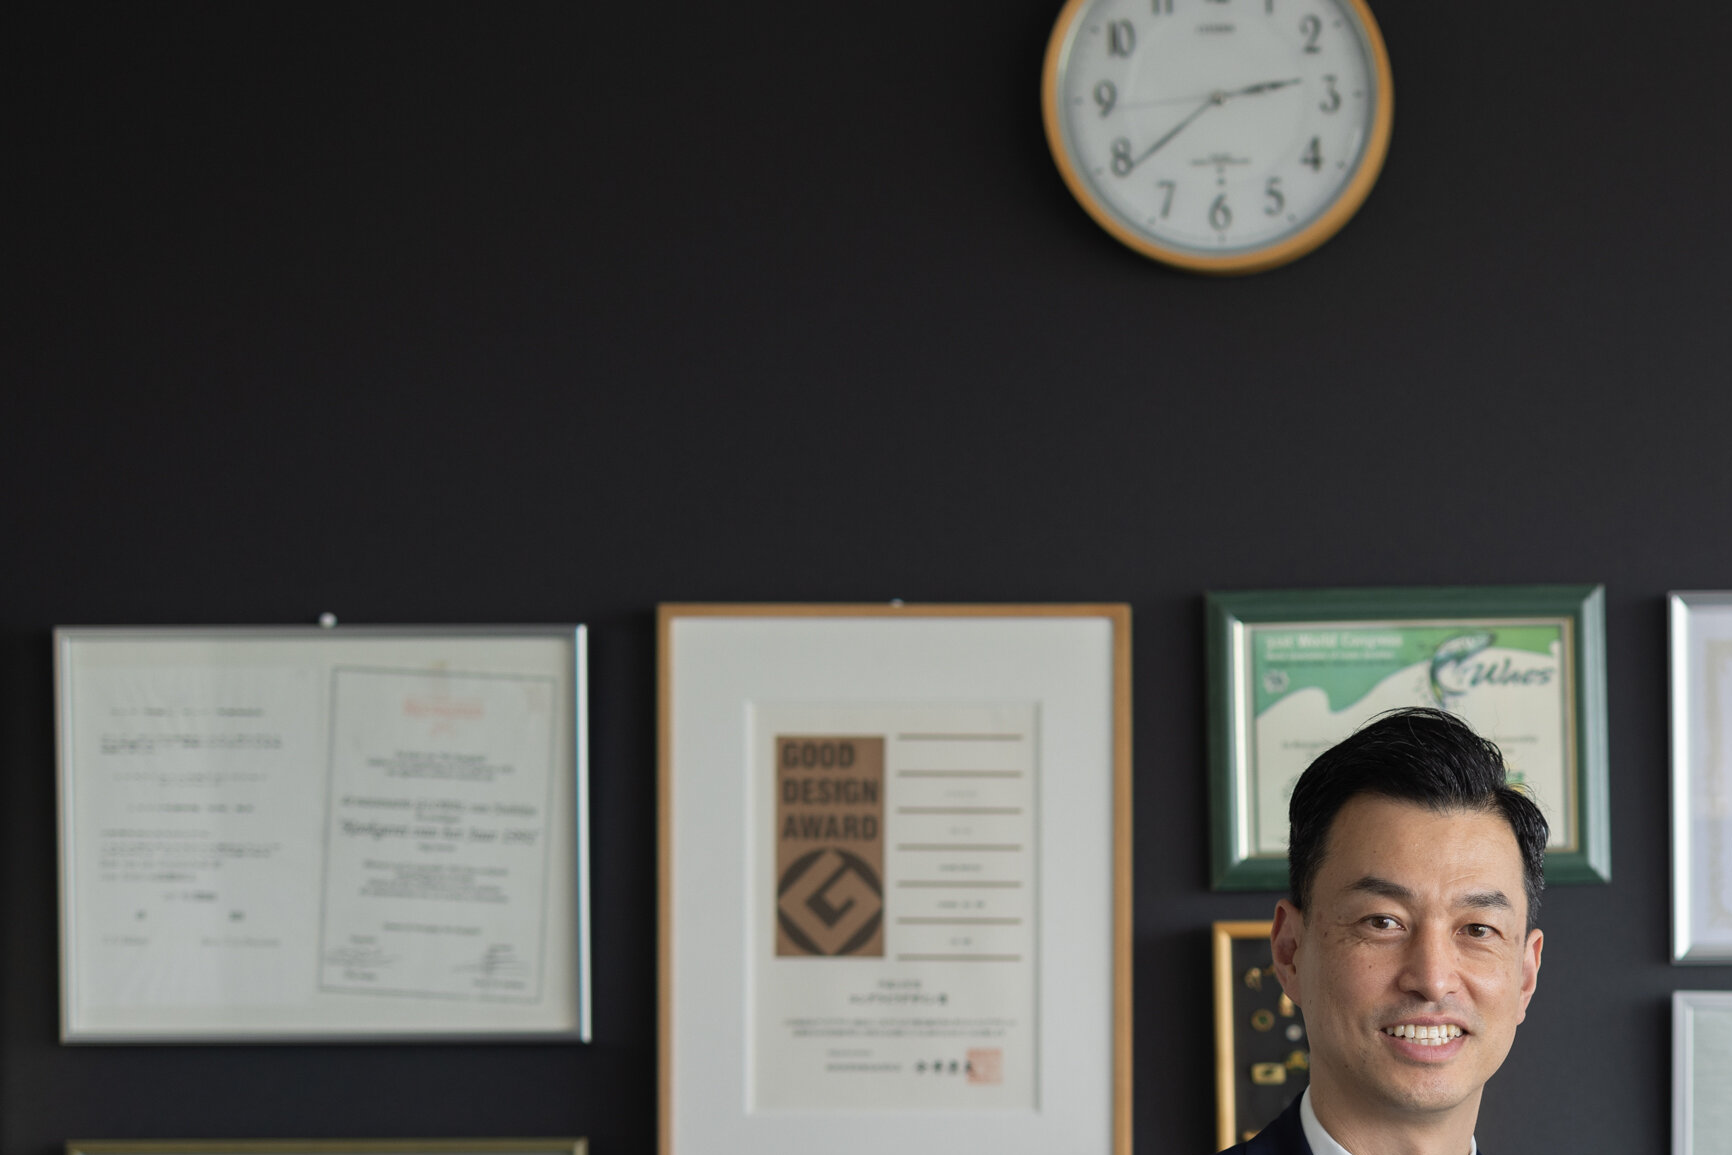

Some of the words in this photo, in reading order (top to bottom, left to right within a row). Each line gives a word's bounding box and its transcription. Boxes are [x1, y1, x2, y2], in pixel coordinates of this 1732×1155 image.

[1107, 19, 1136, 58] 10
[1300, 14, 1322, 53] 2
[1093, 79, 1117, 118] 9
[1320, 75, 1342, 113] 3
[1110, 137, 1134, 177] 8
[1300, 136, 1324, 171] 4
[1157, 180, 1177, 218] 7
[1208, 193, 1232, 231] 6
[1264, 177, 1286, 216] 5
[782, 742, 855, 769] GOOD
[782, 778, 879, 806] DESIGN
[782, 815, 879, 841] AWARD
